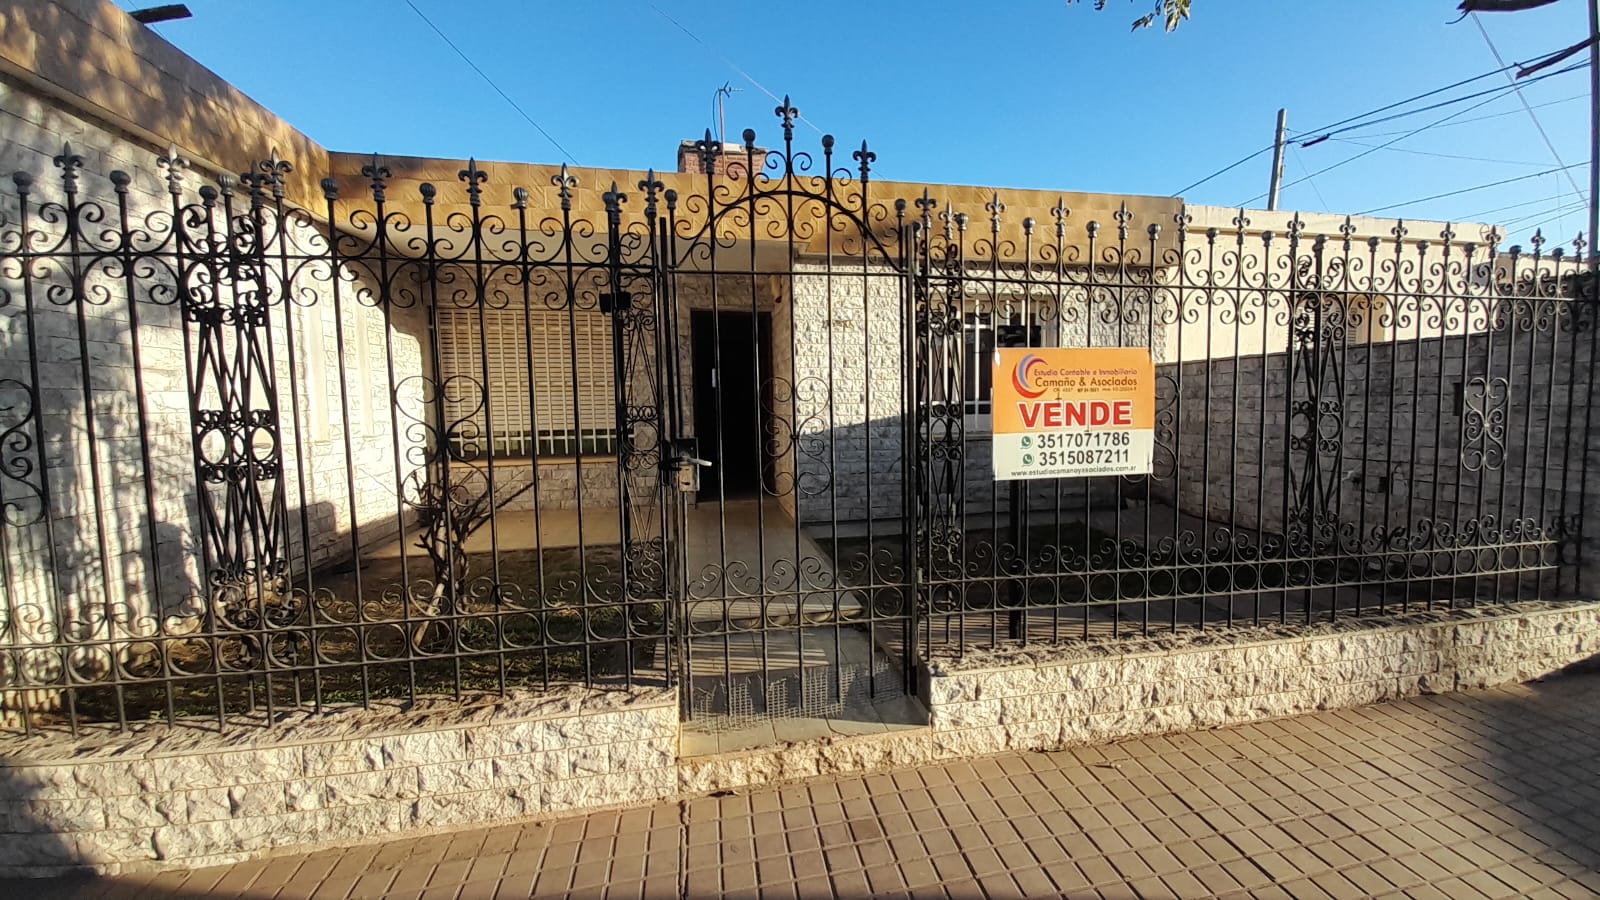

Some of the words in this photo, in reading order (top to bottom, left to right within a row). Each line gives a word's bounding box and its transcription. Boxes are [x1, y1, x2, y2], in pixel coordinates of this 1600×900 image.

[1060, 368, 1091, 376] Contable
[1035, 376, 1075, 387] Camaño
[1079, 377, 1086, 386] &
[1090, 375, 1137, 386] Asociados
[1018, 401, 1132, 427] VENDE
[1037, 432, 1130, 449] 3517071786
[1039, 449, 1129, 466] 3515087211
[1011, 466, 1136, 477] www.estudiocamanoyasociados.com.ar
